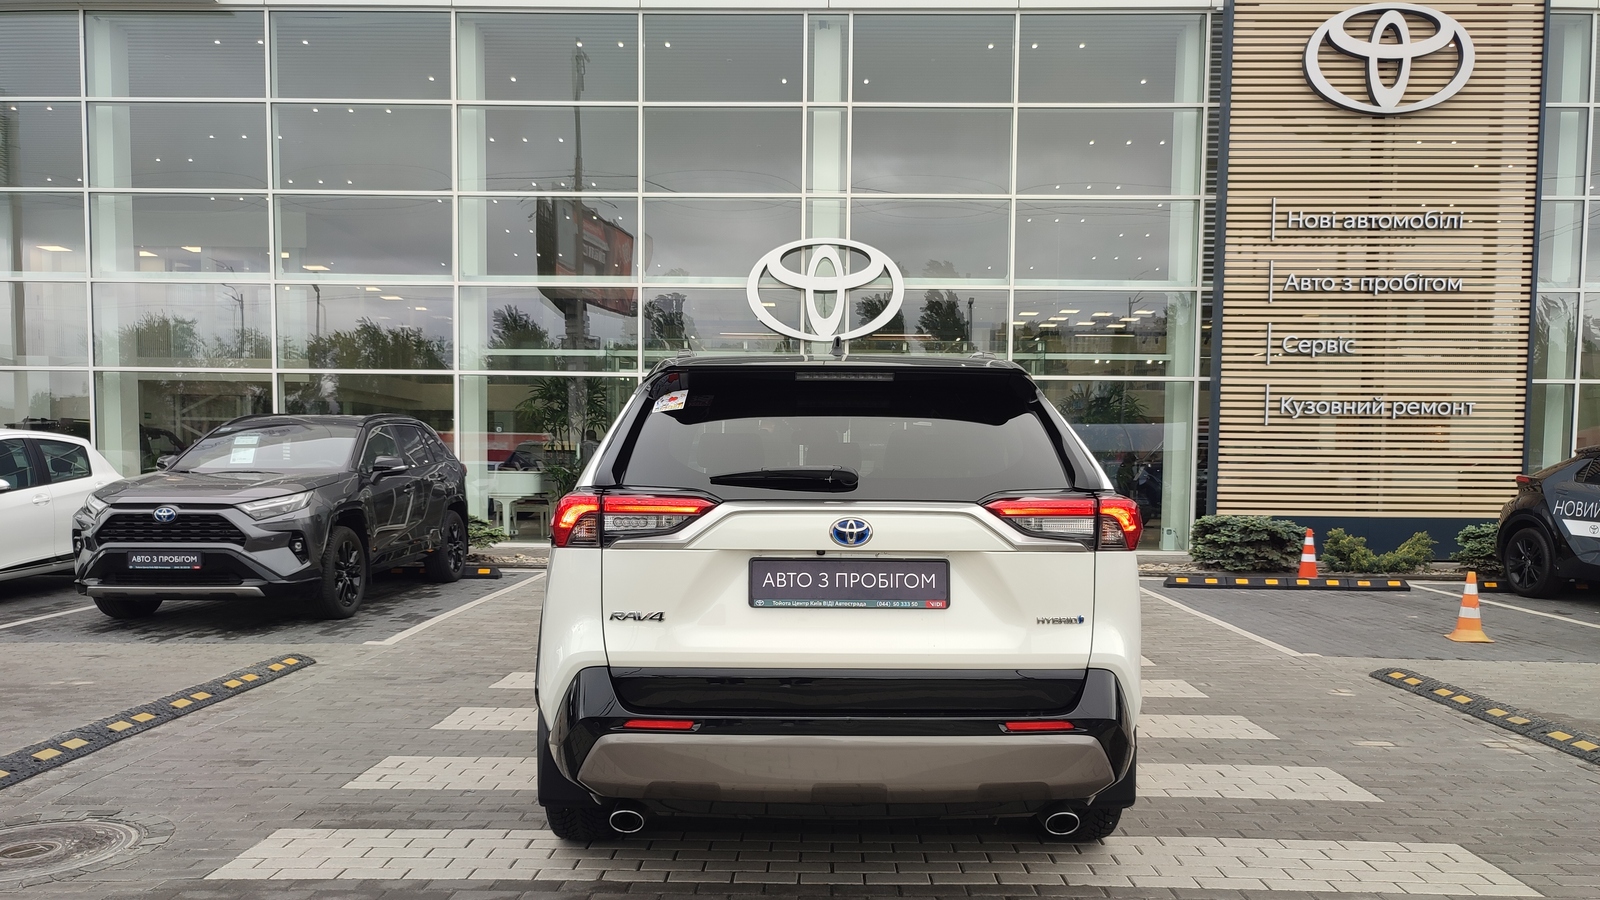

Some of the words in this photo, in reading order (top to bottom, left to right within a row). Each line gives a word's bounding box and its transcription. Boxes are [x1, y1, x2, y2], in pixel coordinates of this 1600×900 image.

[1287, 210, 1337, 229] Нові
[1343, 210, 1465, 229] автомобілі
[1283, 273, 1335, 291] Авто
[1341, 276, 1353, 291] з
[1360, 273, 1463, 296] пробігом
[1282, 335, 1356, 358] Сервіс
[1280, 396, 1386, 418] Кузовний
[1391, 401, 1476, 419] ремонт
[131, 555, 151, 563] АВТО
[159, 555, 198, 563] ПРОБІГОМ
[762, 572, 812, 588] АВТО
[818, 572, 829, 588] З
[835, 572, 936, 589] ПРОБІГОМ
[609, 610, 666, 622] RAV4
[1036, 616, 1078, 625] HYBRID
